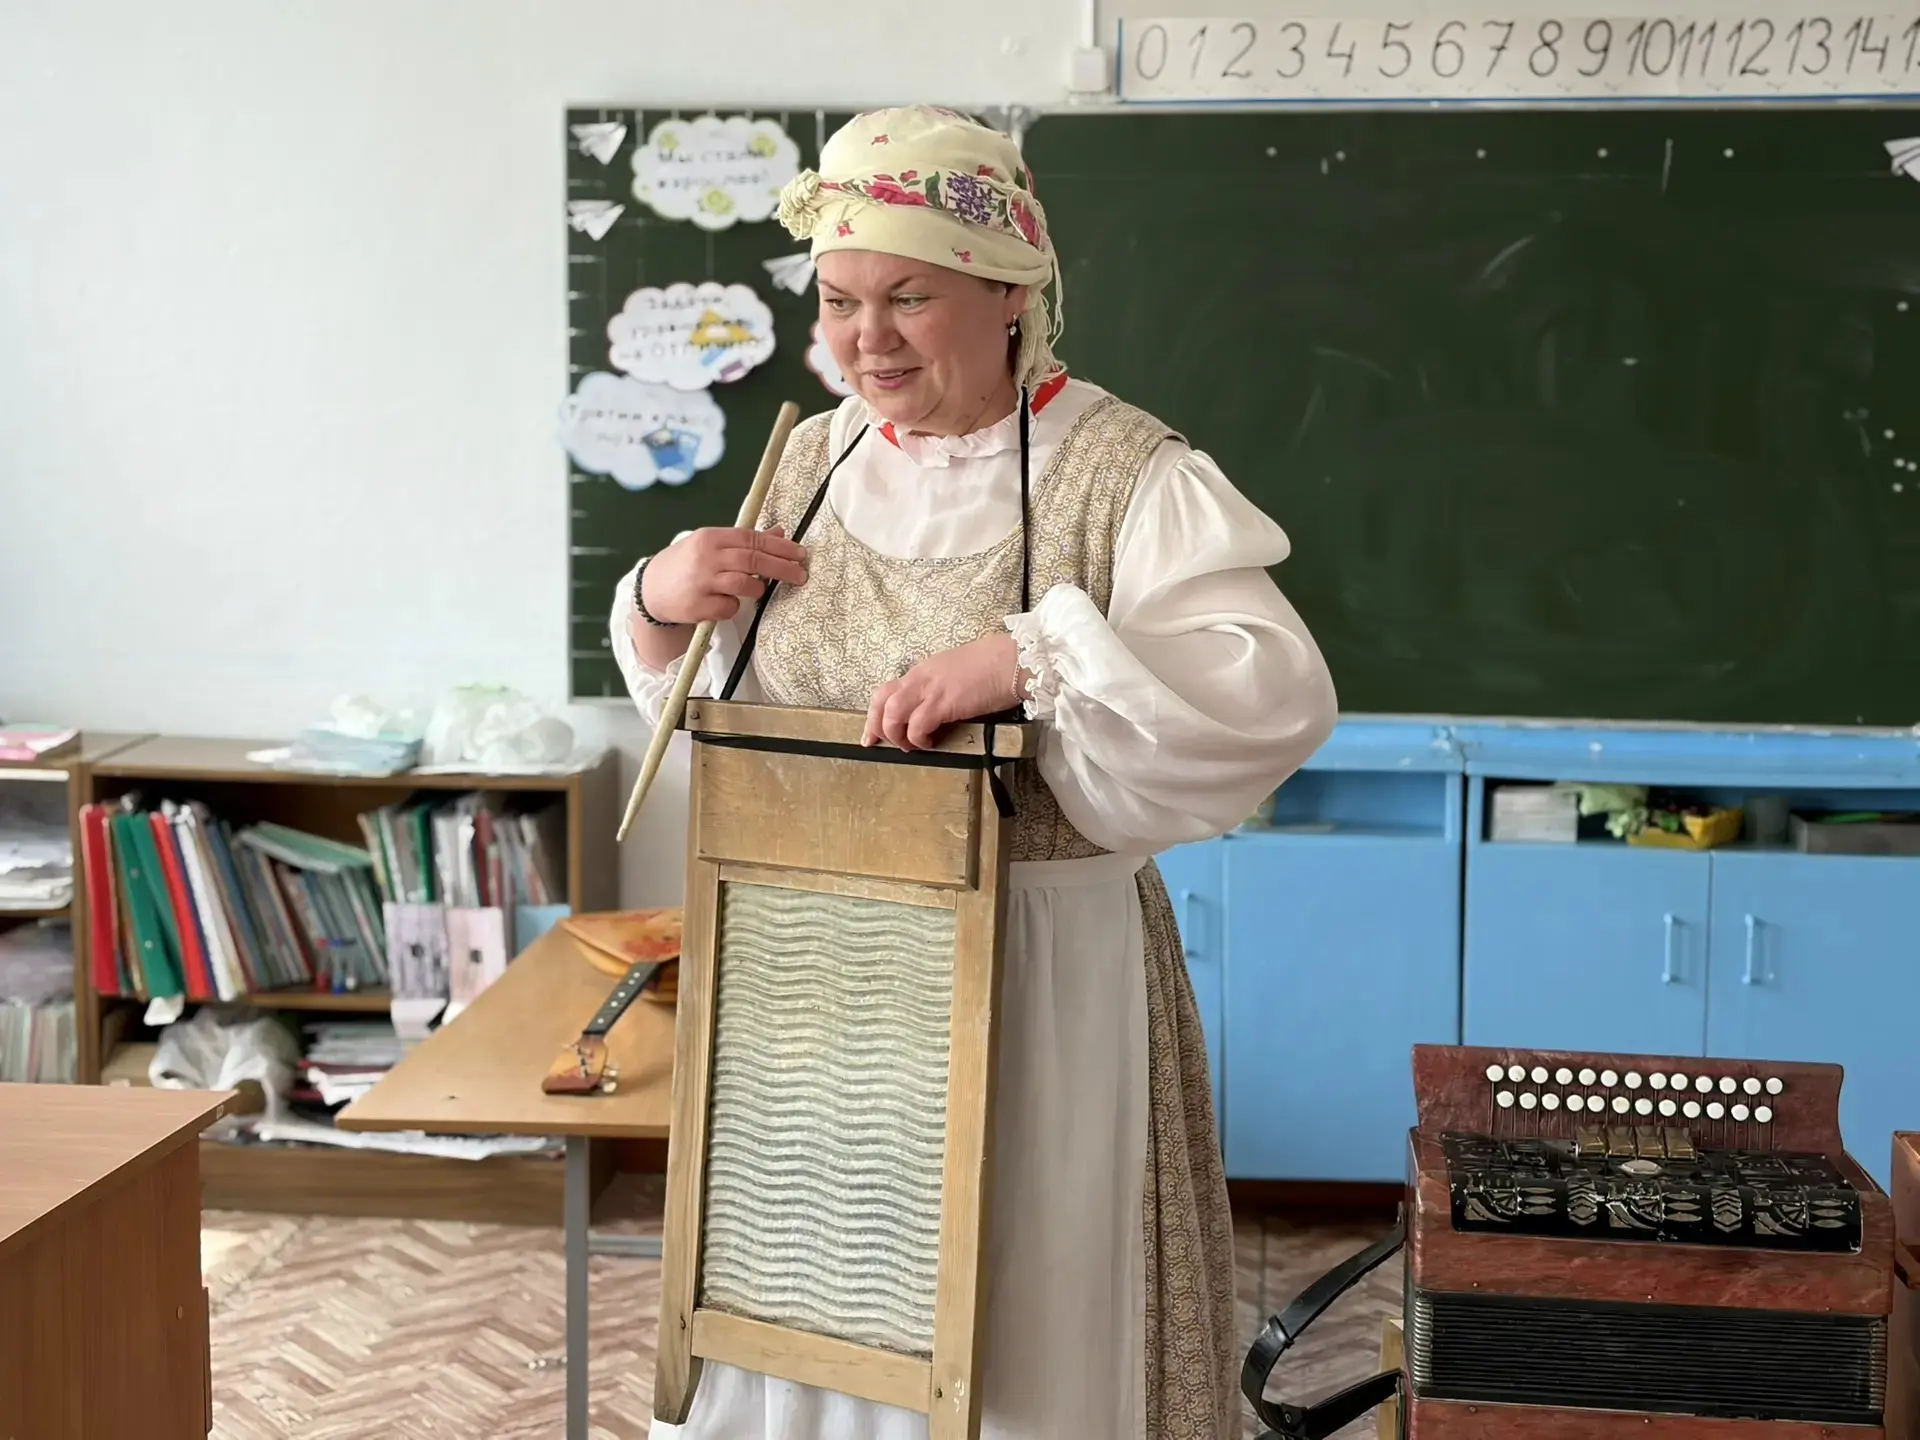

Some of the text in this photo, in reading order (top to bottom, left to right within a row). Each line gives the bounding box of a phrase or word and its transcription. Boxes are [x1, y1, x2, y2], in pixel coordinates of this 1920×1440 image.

[1136, 16, 1920, 80] 0 1 2 3 4 5 6 7 8 9 10 11 12 13 14 1
